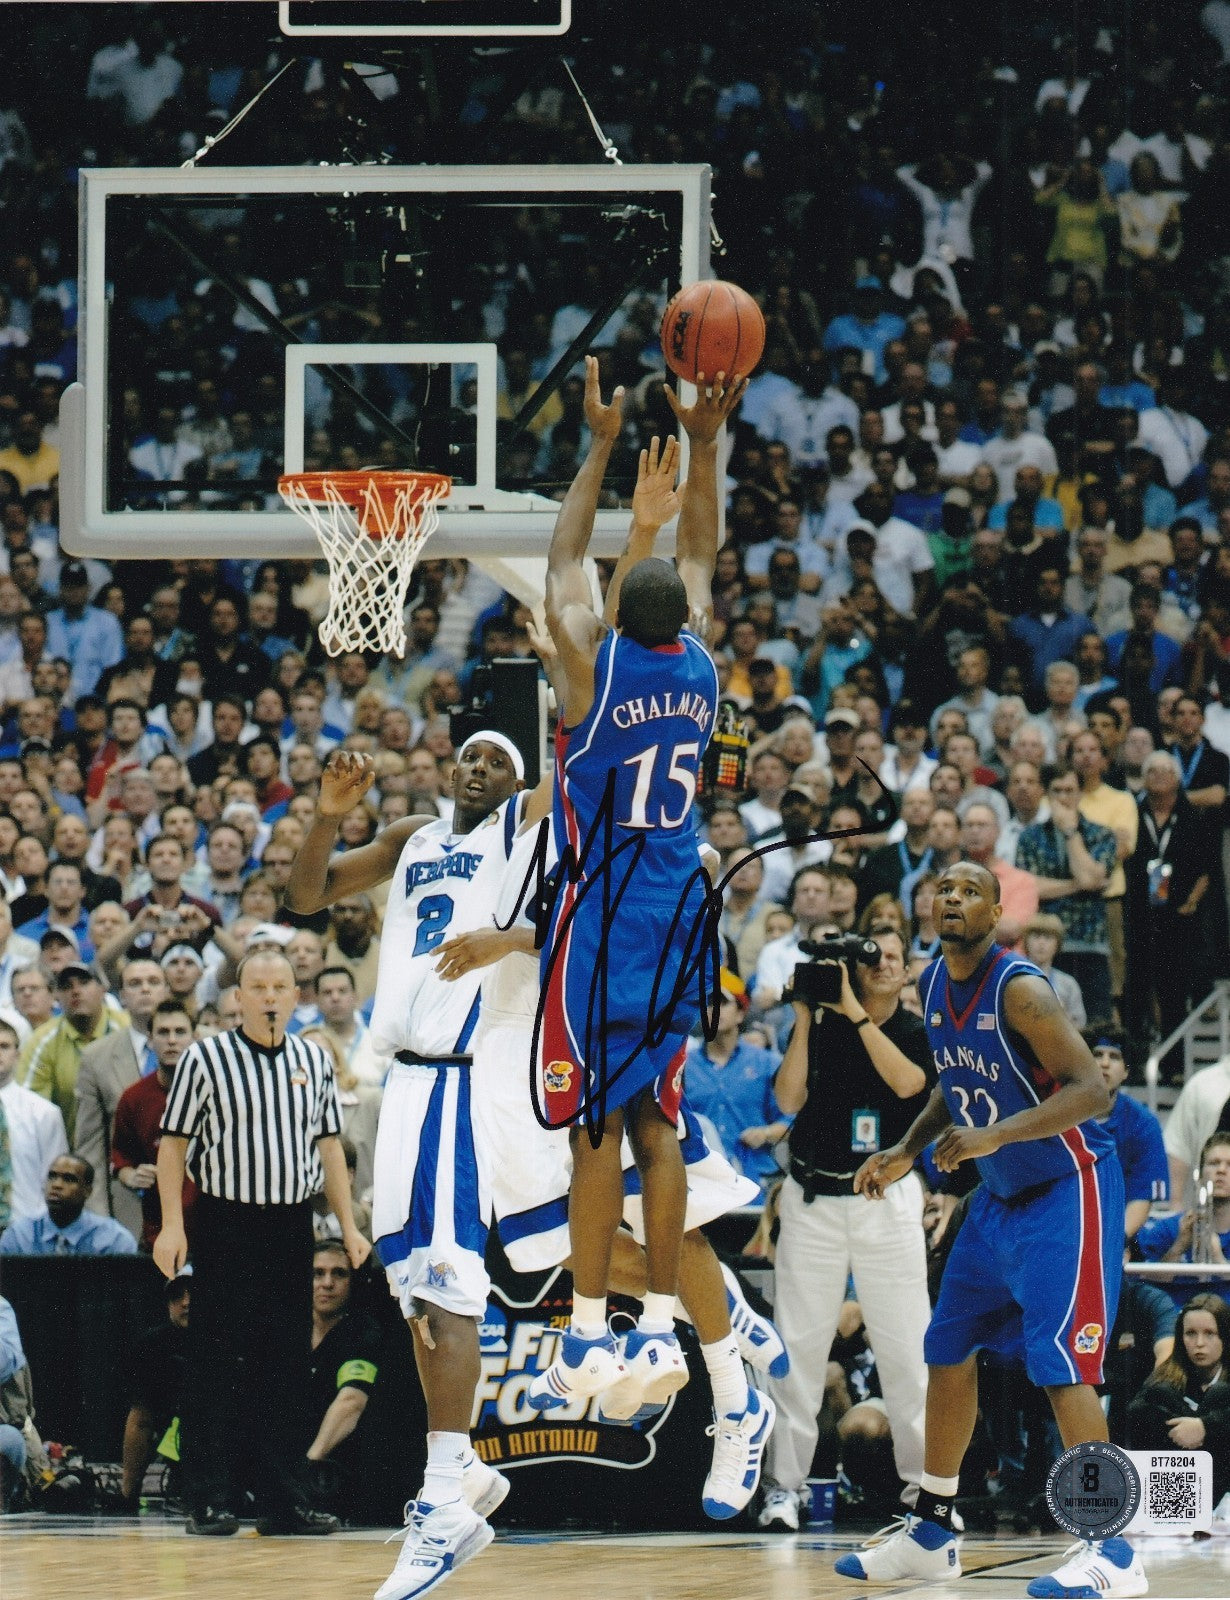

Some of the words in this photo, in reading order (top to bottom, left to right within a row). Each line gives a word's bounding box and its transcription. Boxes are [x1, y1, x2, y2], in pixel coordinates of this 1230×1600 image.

[612, 692, 711, 732] CHALMERS
[616, 742, 699, 829] 15
[405, 852, 484, 899] MEMPHIS
[411, 893, 455, 957] 2
[932, 1045, 999, 1081] KANSAS
[951, 1086, 998, 1128] 32
[474, 1436, 502, 1461] AN
[508, 1428, 598, 1456] ANTONIO
[933, 1504, 948, 1517] 32
